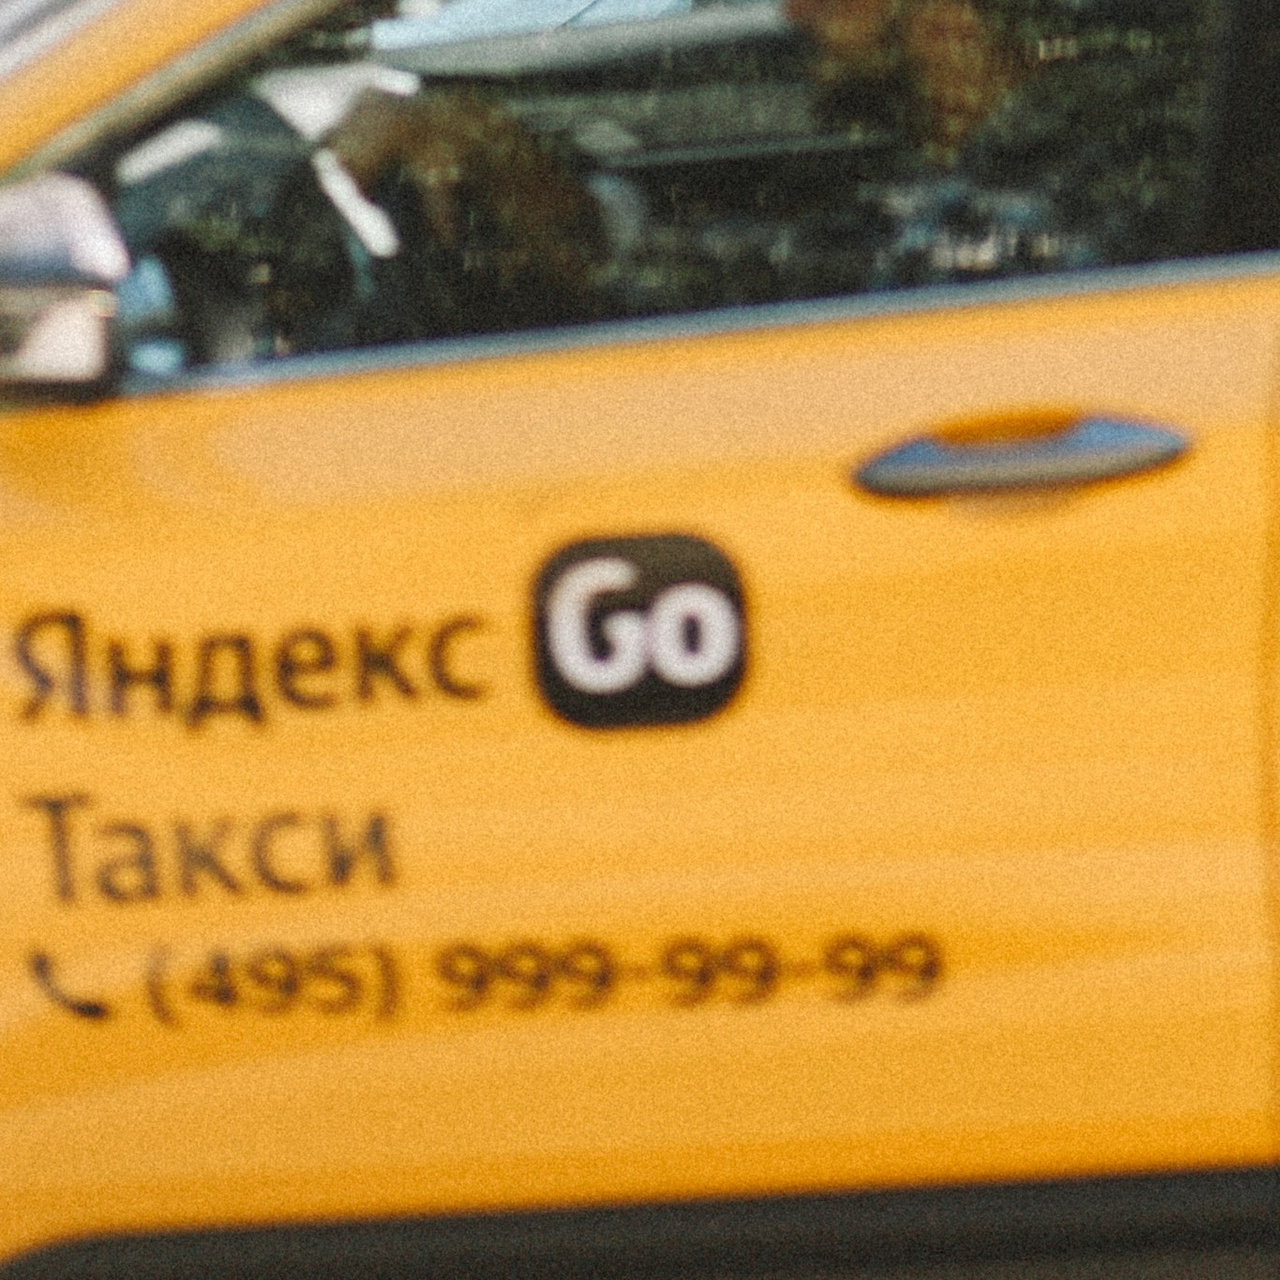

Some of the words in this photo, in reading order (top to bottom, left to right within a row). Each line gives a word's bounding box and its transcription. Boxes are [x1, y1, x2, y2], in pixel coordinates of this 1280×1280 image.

[14, 610, 496, 728] Яндекс
[545, 556, 744, 696] Go
[28, 794, 400, 906] Такси
[146, 944, 402, 1026] (495)
[434, 934, 944, 1012] 999-99-99
